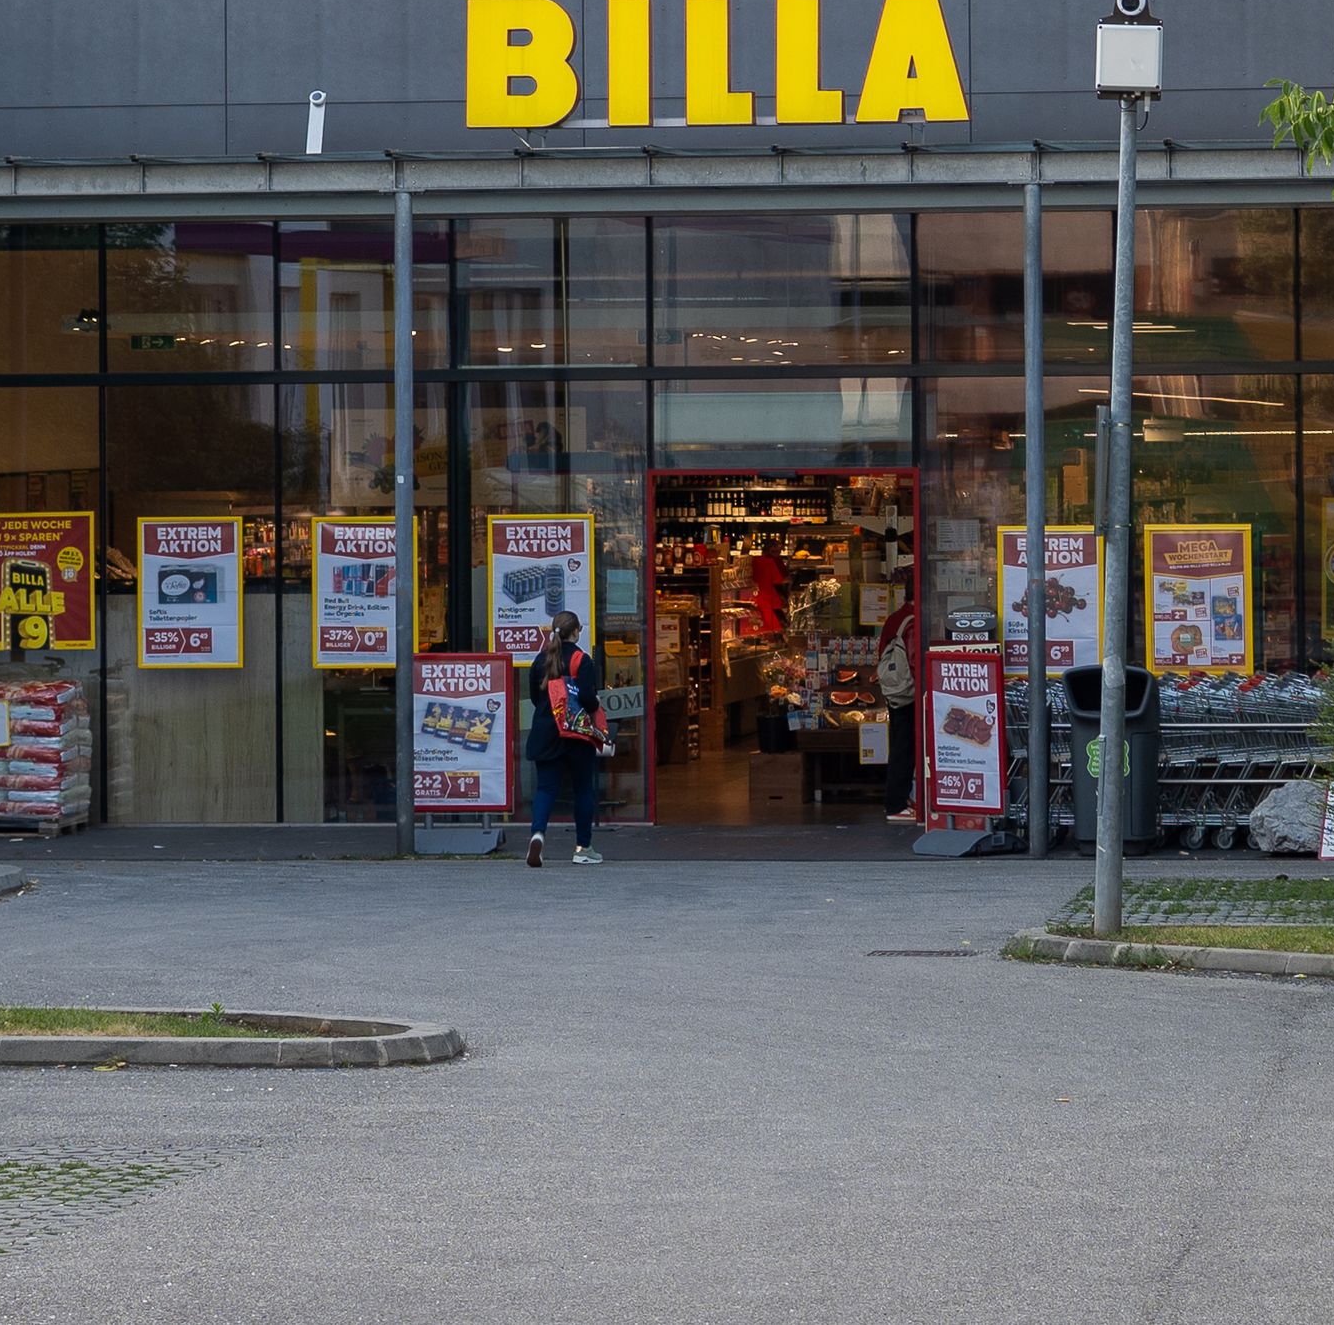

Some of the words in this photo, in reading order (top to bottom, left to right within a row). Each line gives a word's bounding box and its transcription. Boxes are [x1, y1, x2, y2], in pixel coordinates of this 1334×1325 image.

[1, 521, 28, 529] JEDE
[31, 520, 72, 529] WOCHE
[157, 526, 222, 540] EXTREM
[334, 527, 396, 540] EXTREM
[506, 526, 571, 539] EXTREM
[158, 540, 222, 553] AKTION
[334, 541, 396, 553] AKTION
[507, 539, 572, 553] AKTION
[1017, 537, 1083, 551] EREM
[1178, 541, 1217, 553] MEGA
[1017, 551, 1083, 564] ATION
[1169, 552, 1229, 561] WOCHENSTART
[12, 572, 44, 586] BILLA
[18, 615, 49, 649] 9
[148, 631, 179, 643] -35%
[323, 630, 354, 641] -37%
[498, 629, 538, 643] 12+12
[421, 664, 491, 678] EXTREM
[941, 663, 988, 678] EXTREM
[422, 678, 491, 692] AKTION
[942, 677, 989, 692] AKTION
[603, 692, 642, 712] OM
[414, 775, 442, 788] 2+2
[938, 775, 961, 787] -46%
